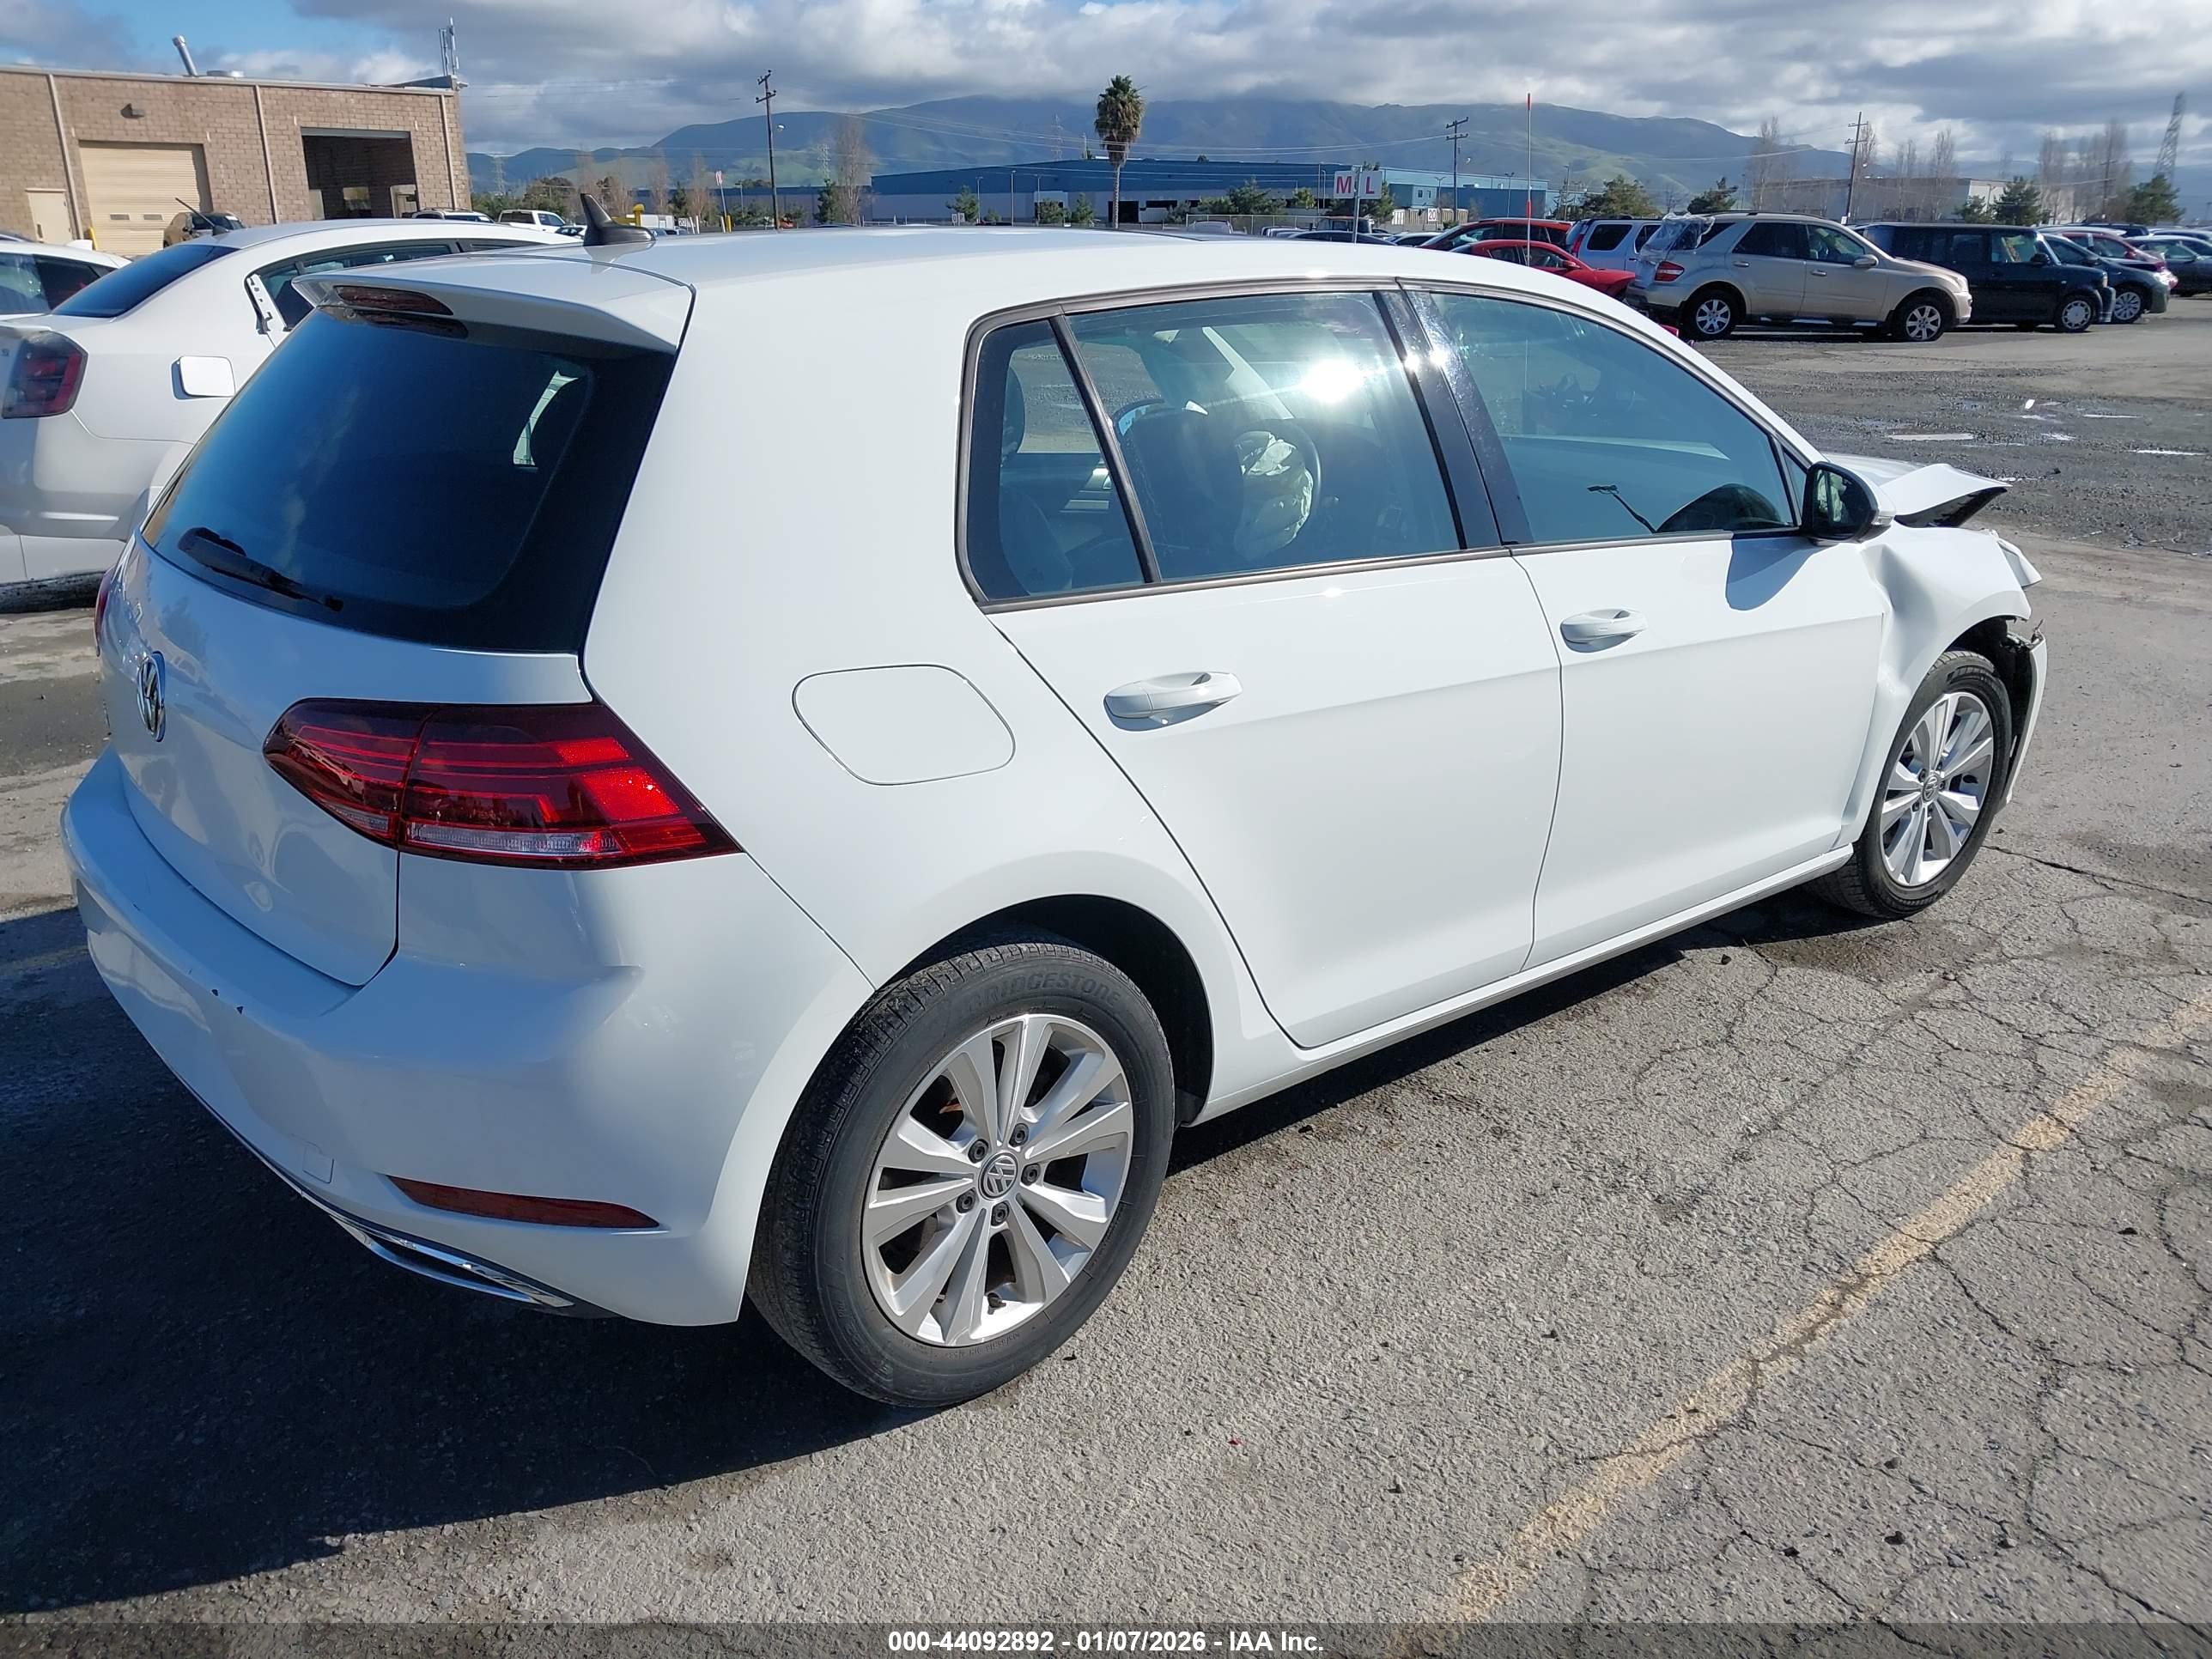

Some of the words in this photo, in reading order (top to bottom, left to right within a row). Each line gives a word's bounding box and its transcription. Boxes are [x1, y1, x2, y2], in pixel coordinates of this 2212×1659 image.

[1336, 176, 1352, 194] M
[1365, 176, 1375, 194] L
[1428, 209, 1437, 221] 20
